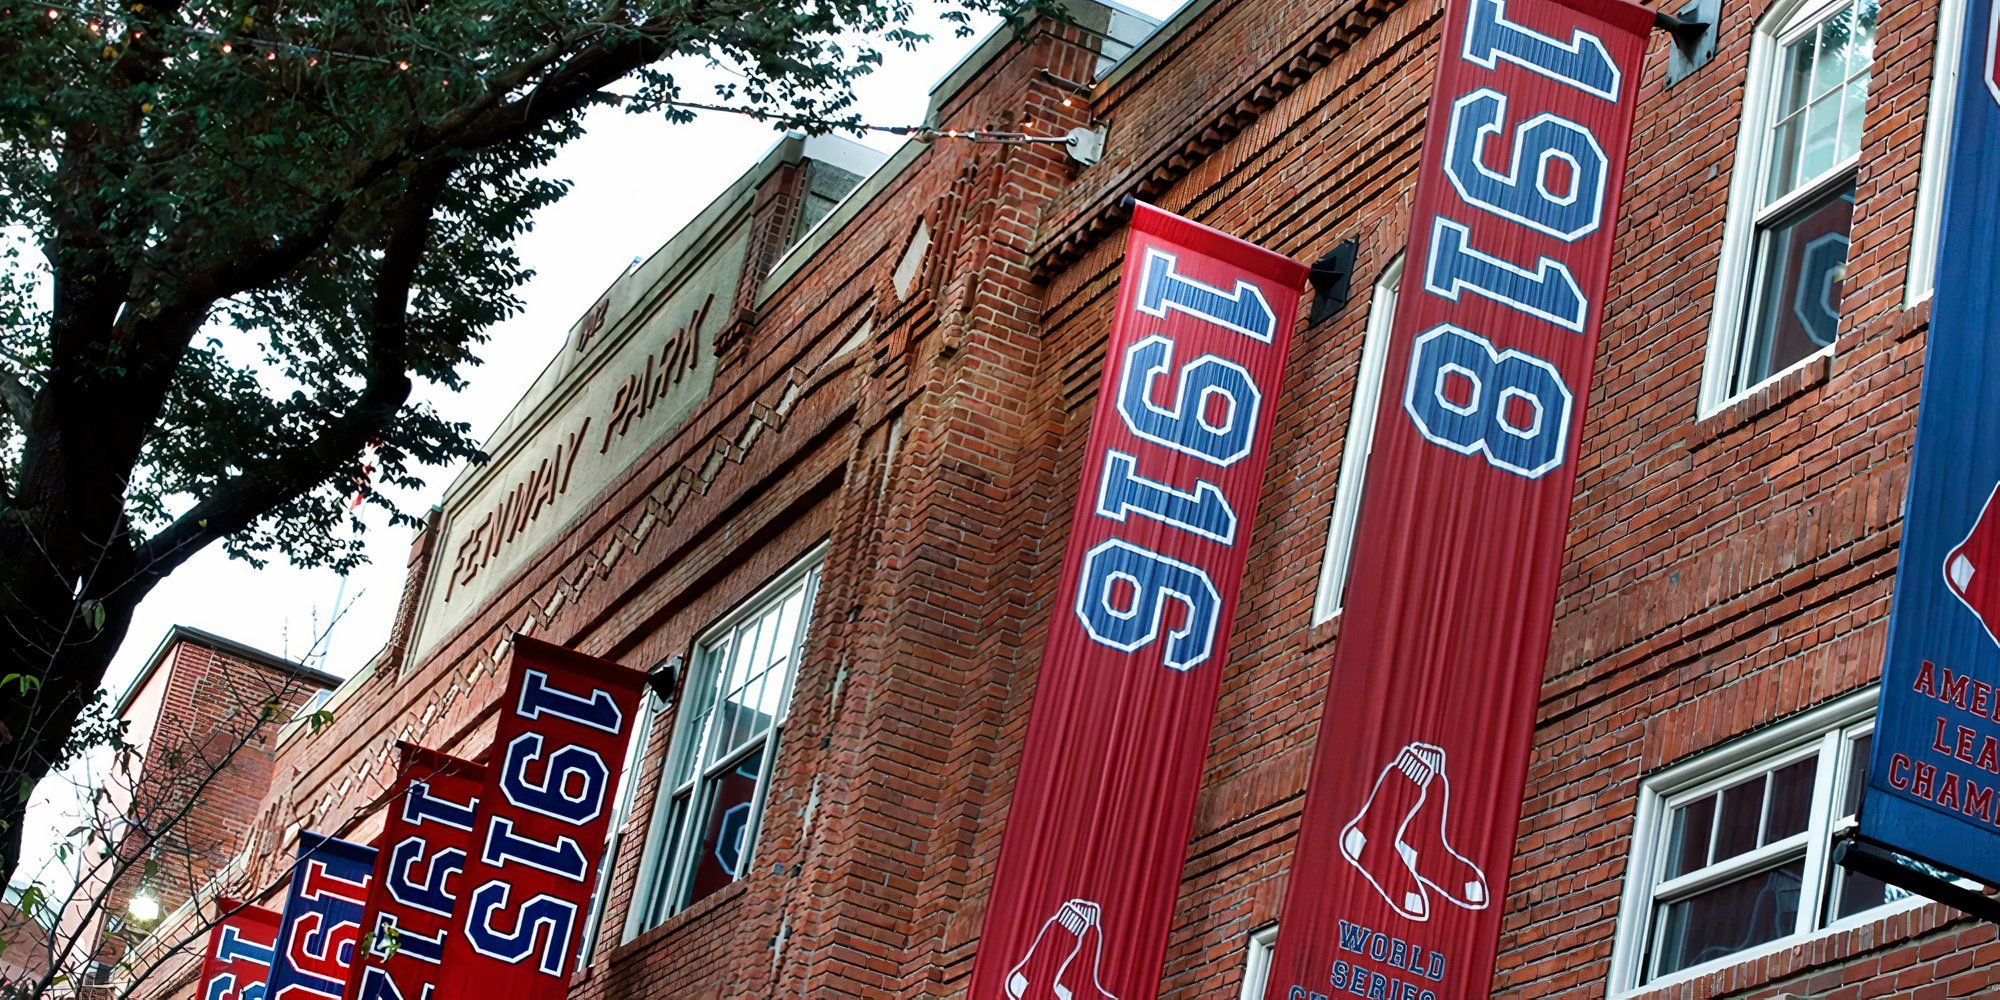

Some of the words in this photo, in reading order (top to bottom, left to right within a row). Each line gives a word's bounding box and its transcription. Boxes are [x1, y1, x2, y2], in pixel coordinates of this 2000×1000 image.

[1404, 0, 1621, 479] 1918
[445, 416, 592, 603] FENWAY
[600, 293, 715, 454] PARK
[1076, 247, 1278, 672] 1916
[275, 858, 375, 1000] 19
[464, 668, 623, 978] 1915
[1888, 752, 2000, 828] CHAM
[1338, 918, 1446, 982] WORLD
